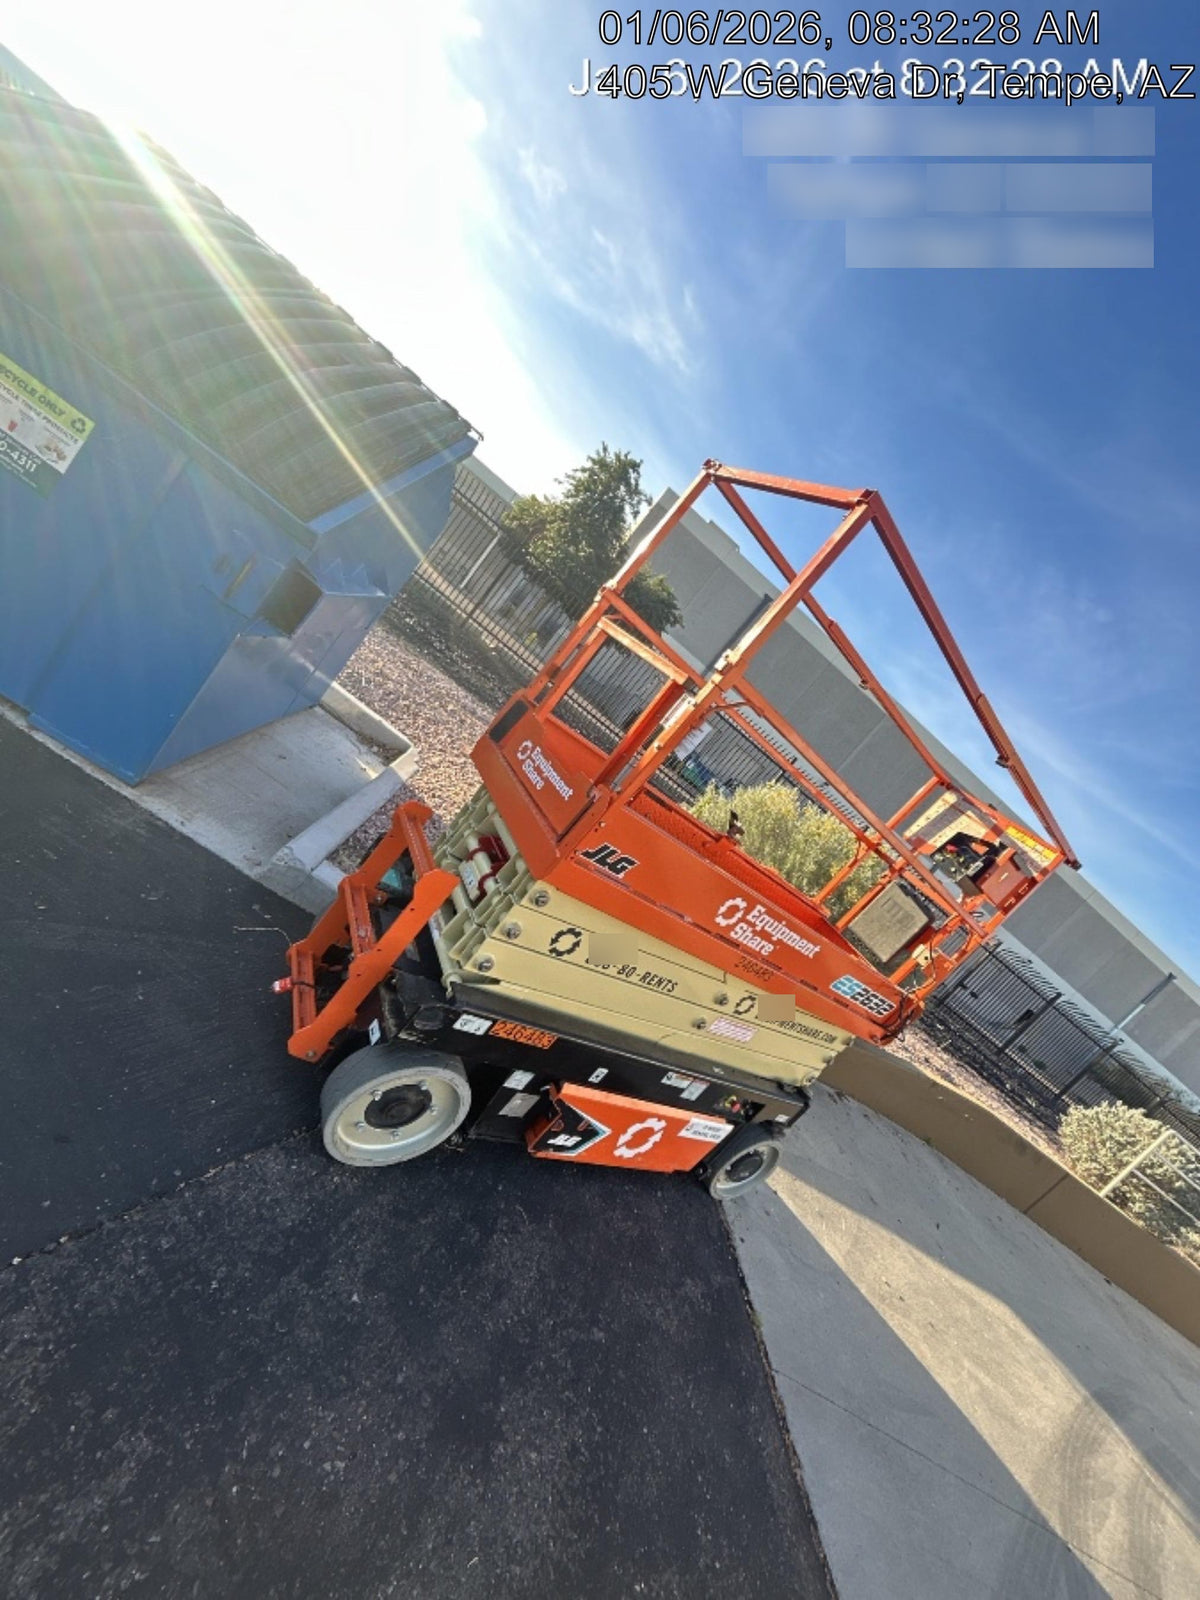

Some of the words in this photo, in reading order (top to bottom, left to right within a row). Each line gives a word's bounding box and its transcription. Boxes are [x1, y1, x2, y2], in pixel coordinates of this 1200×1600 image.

[38, 394, 65, 417] ONLY
[522, 759, 545, 791] Share
[531, 746, 574, 801] Equipment
[576, 842, 641, 879] JLG
[729, 923, 774, 957] Share
[745, 903, 822, 960] Equipment
